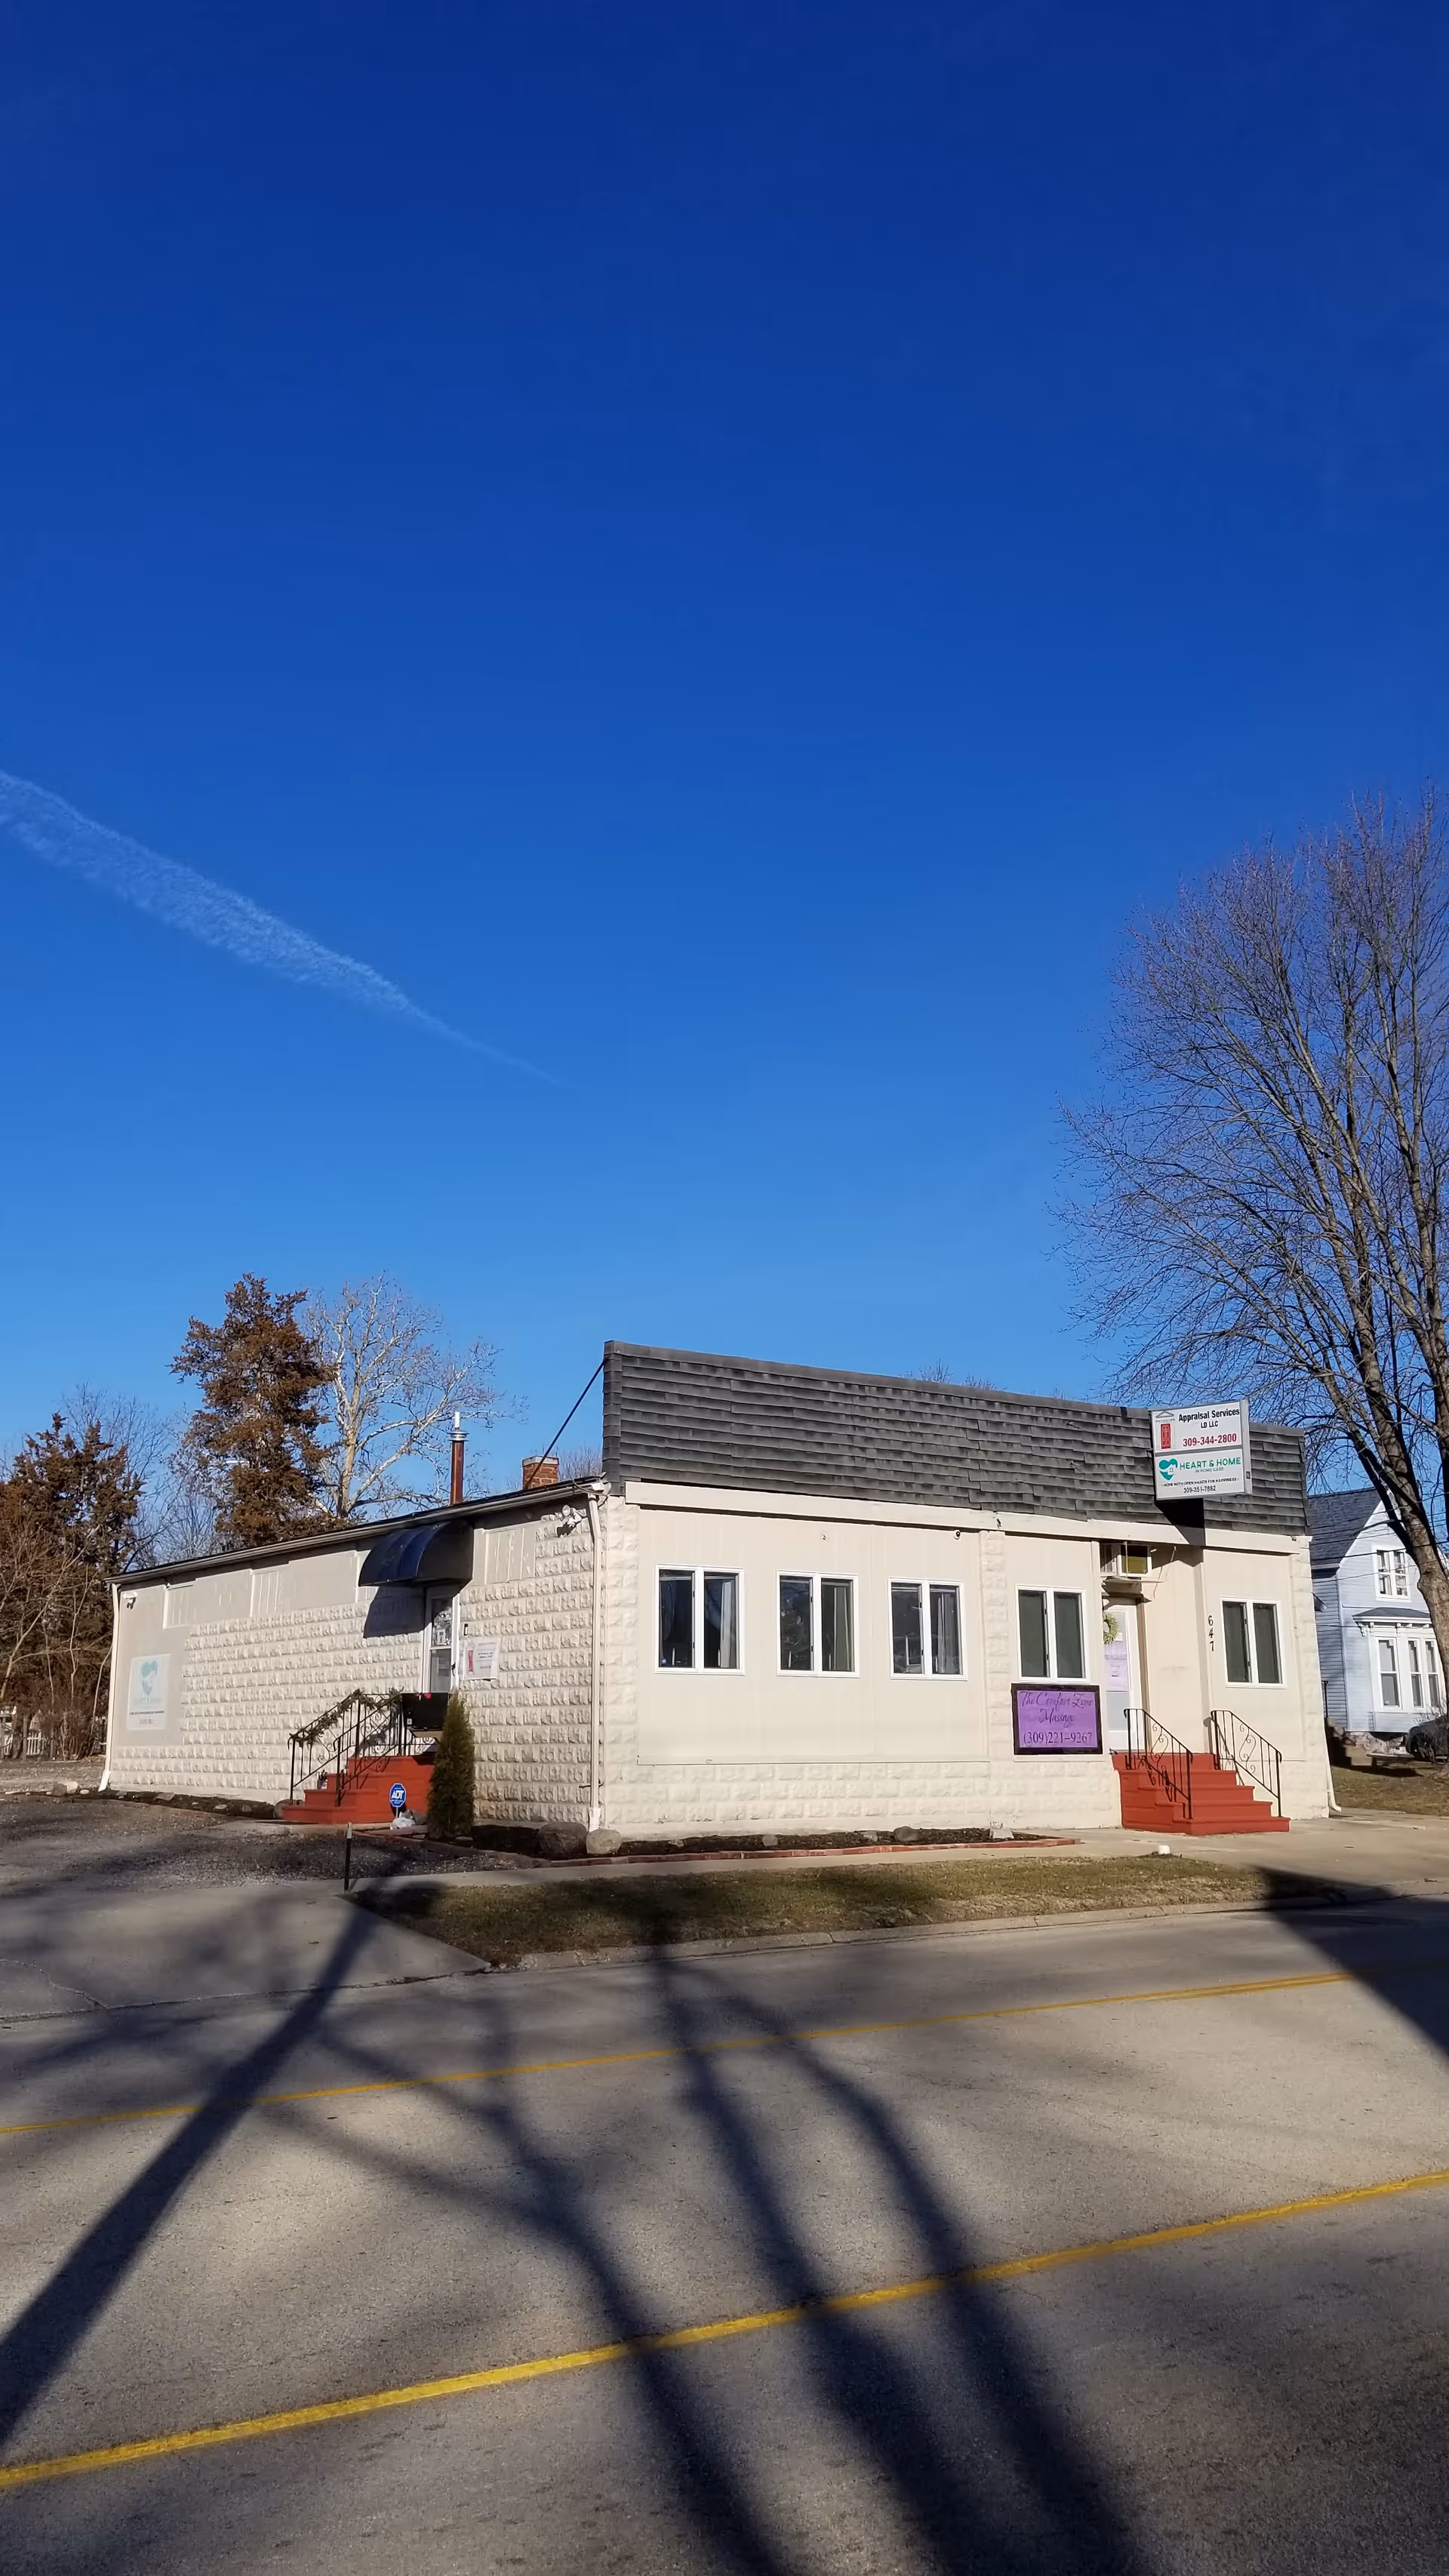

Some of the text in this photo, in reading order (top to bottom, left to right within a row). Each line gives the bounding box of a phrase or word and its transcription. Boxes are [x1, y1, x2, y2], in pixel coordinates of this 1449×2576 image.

[1179, 1408, 1240, 1423] Appraisal Services
[1183, 1433, 1237, 1447] 309-344-2800
[1180, 1460, 1207, 1470] HEART
[1217, 1457, 1241, 1467] HOME
[1020, 1691, 1093, 1710] The Comfort Zone
[1039, 1707, 1075, 1728] Massage
[1023, 1731, 1092, 1745] (309)221-9267
[391, 1790, 405, 1799] ADT
